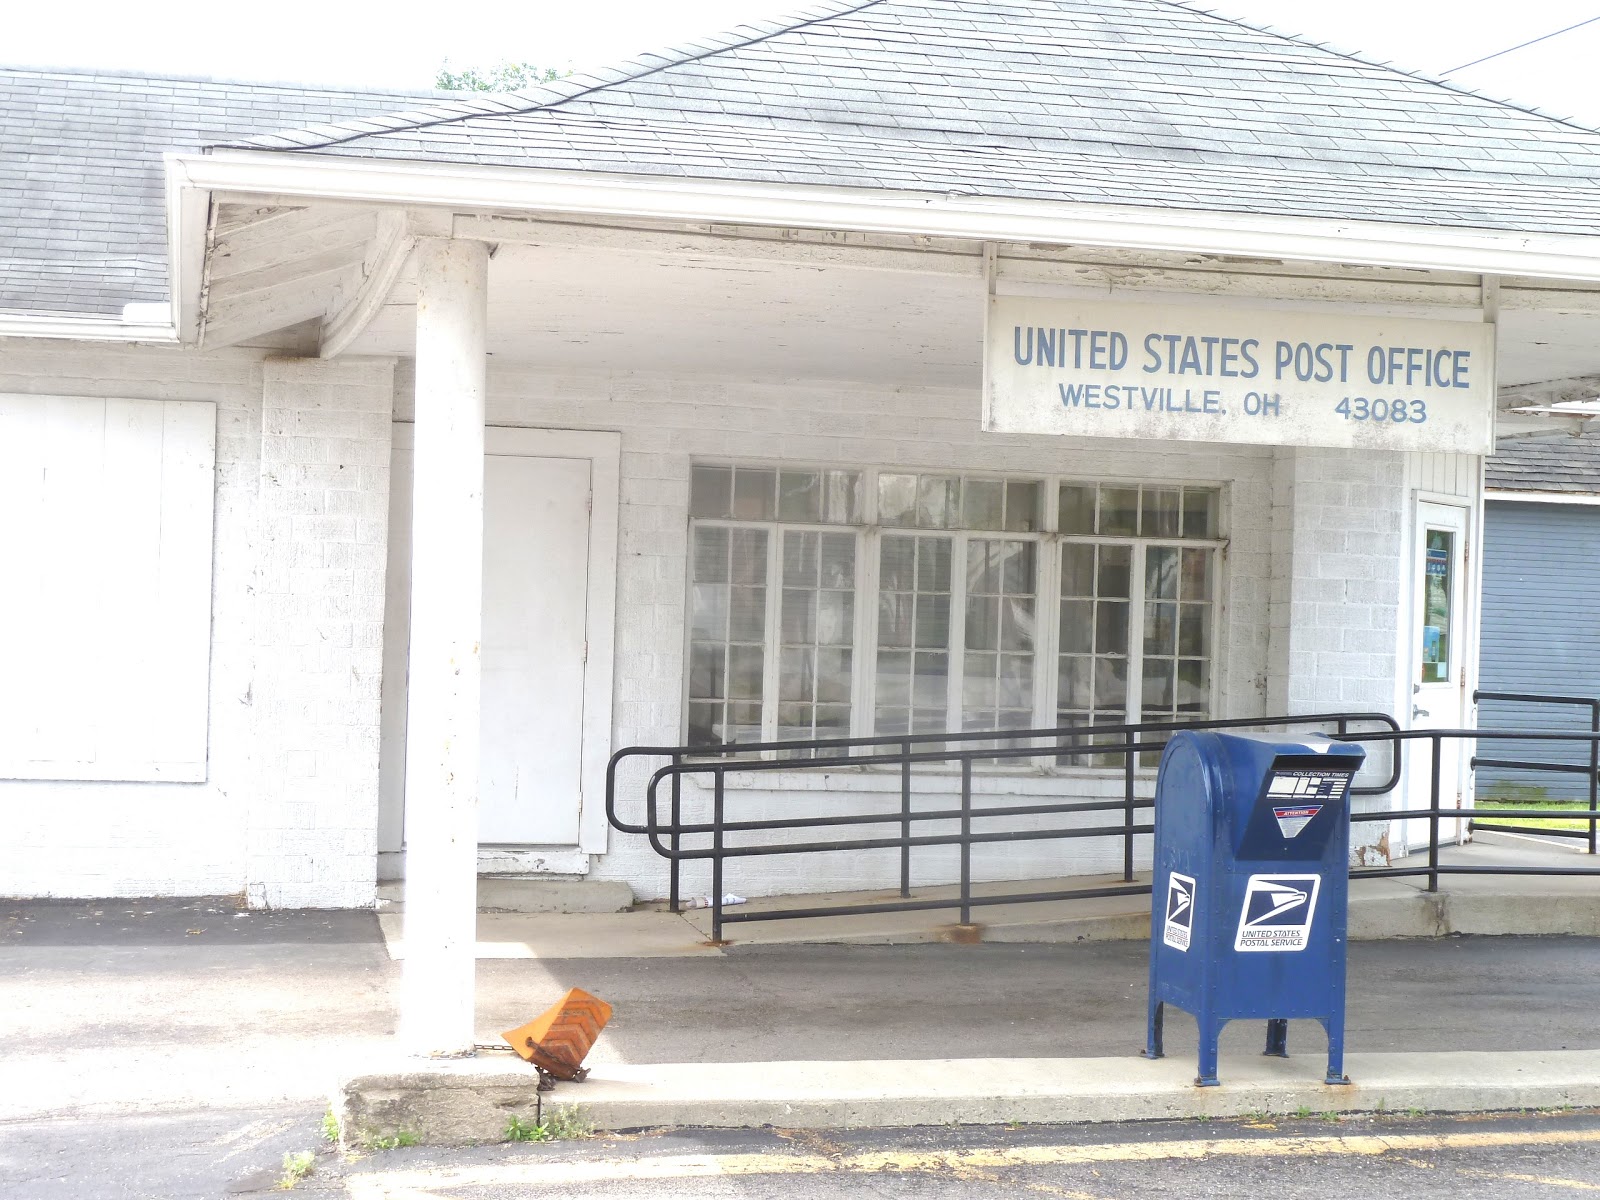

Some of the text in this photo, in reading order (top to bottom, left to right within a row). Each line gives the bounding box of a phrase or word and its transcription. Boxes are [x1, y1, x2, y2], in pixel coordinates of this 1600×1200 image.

[1014, 326, 1471, 389] UNITED STATES POST OFFICE
[1243, 391, 1281, 416] OH
[1335, 397, 1428, 425] 43083
[1240, 938, 1303, 947] POSTAL SERVICE
[1242, 930, 1272, 938] UNITED
